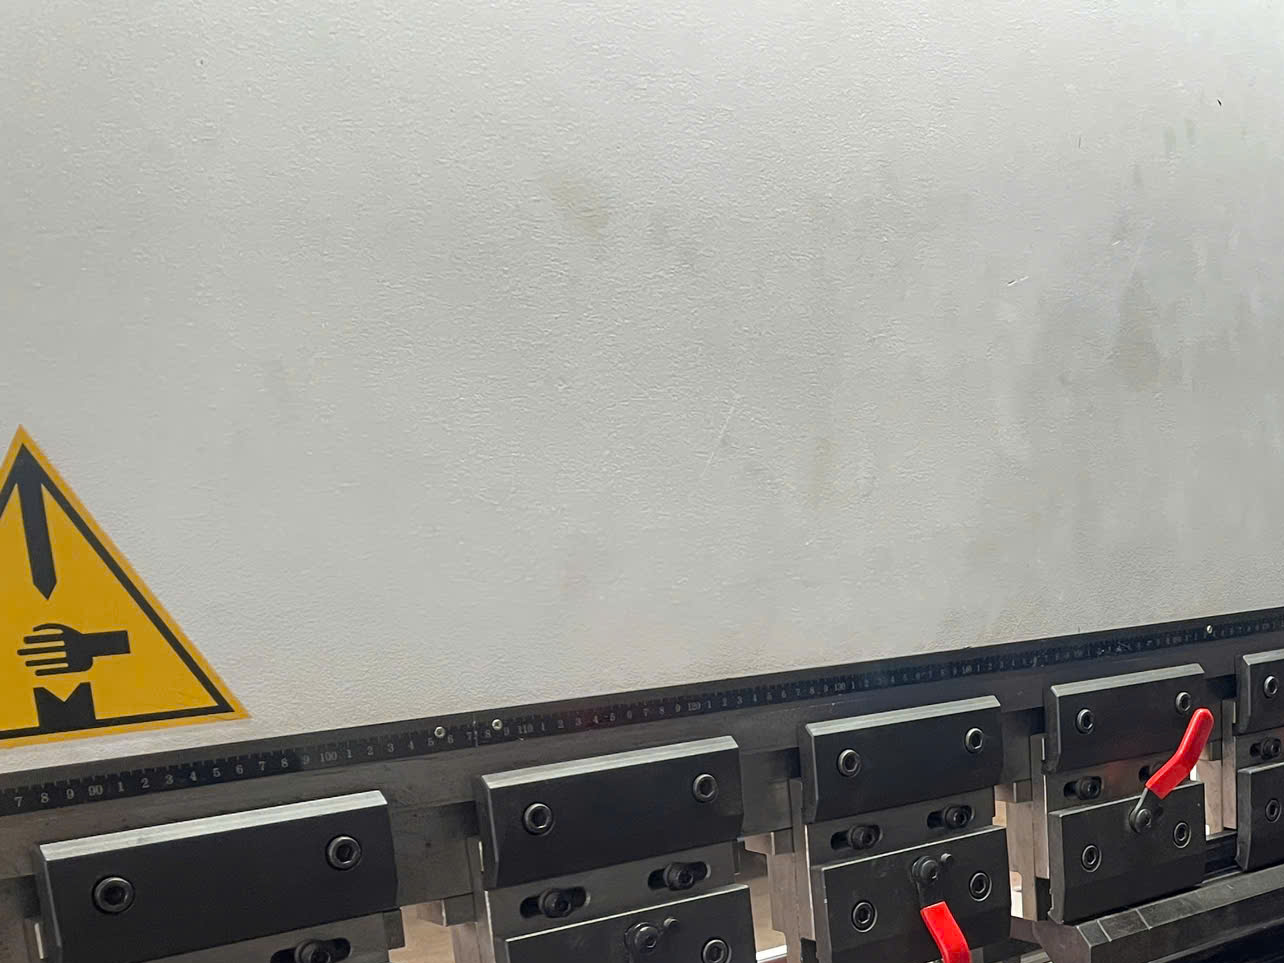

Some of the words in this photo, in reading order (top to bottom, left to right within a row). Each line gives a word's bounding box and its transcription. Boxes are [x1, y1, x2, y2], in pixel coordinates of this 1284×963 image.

[14, 796, 24, 808] 7
[41, 793, 49, 803] 8
[66, 789, 74, 800] 9
[88, 784, 103, 796] 90
[117, 781, 124, 792] 1
[141, 778, 150, 789] 2
[165, 775, 174, 785] 3
[190, 771, 197, 782] 4
[213, 767, 221, 778] 5
[236, 764, 244, 774] 6
[258, 761, 266, 771] 7
[281, 758, 289, 768] 8
[303, 755, 310, 765] 9
[320, 751, 338, 762] 100
[518, 724, 534, 734] 110
